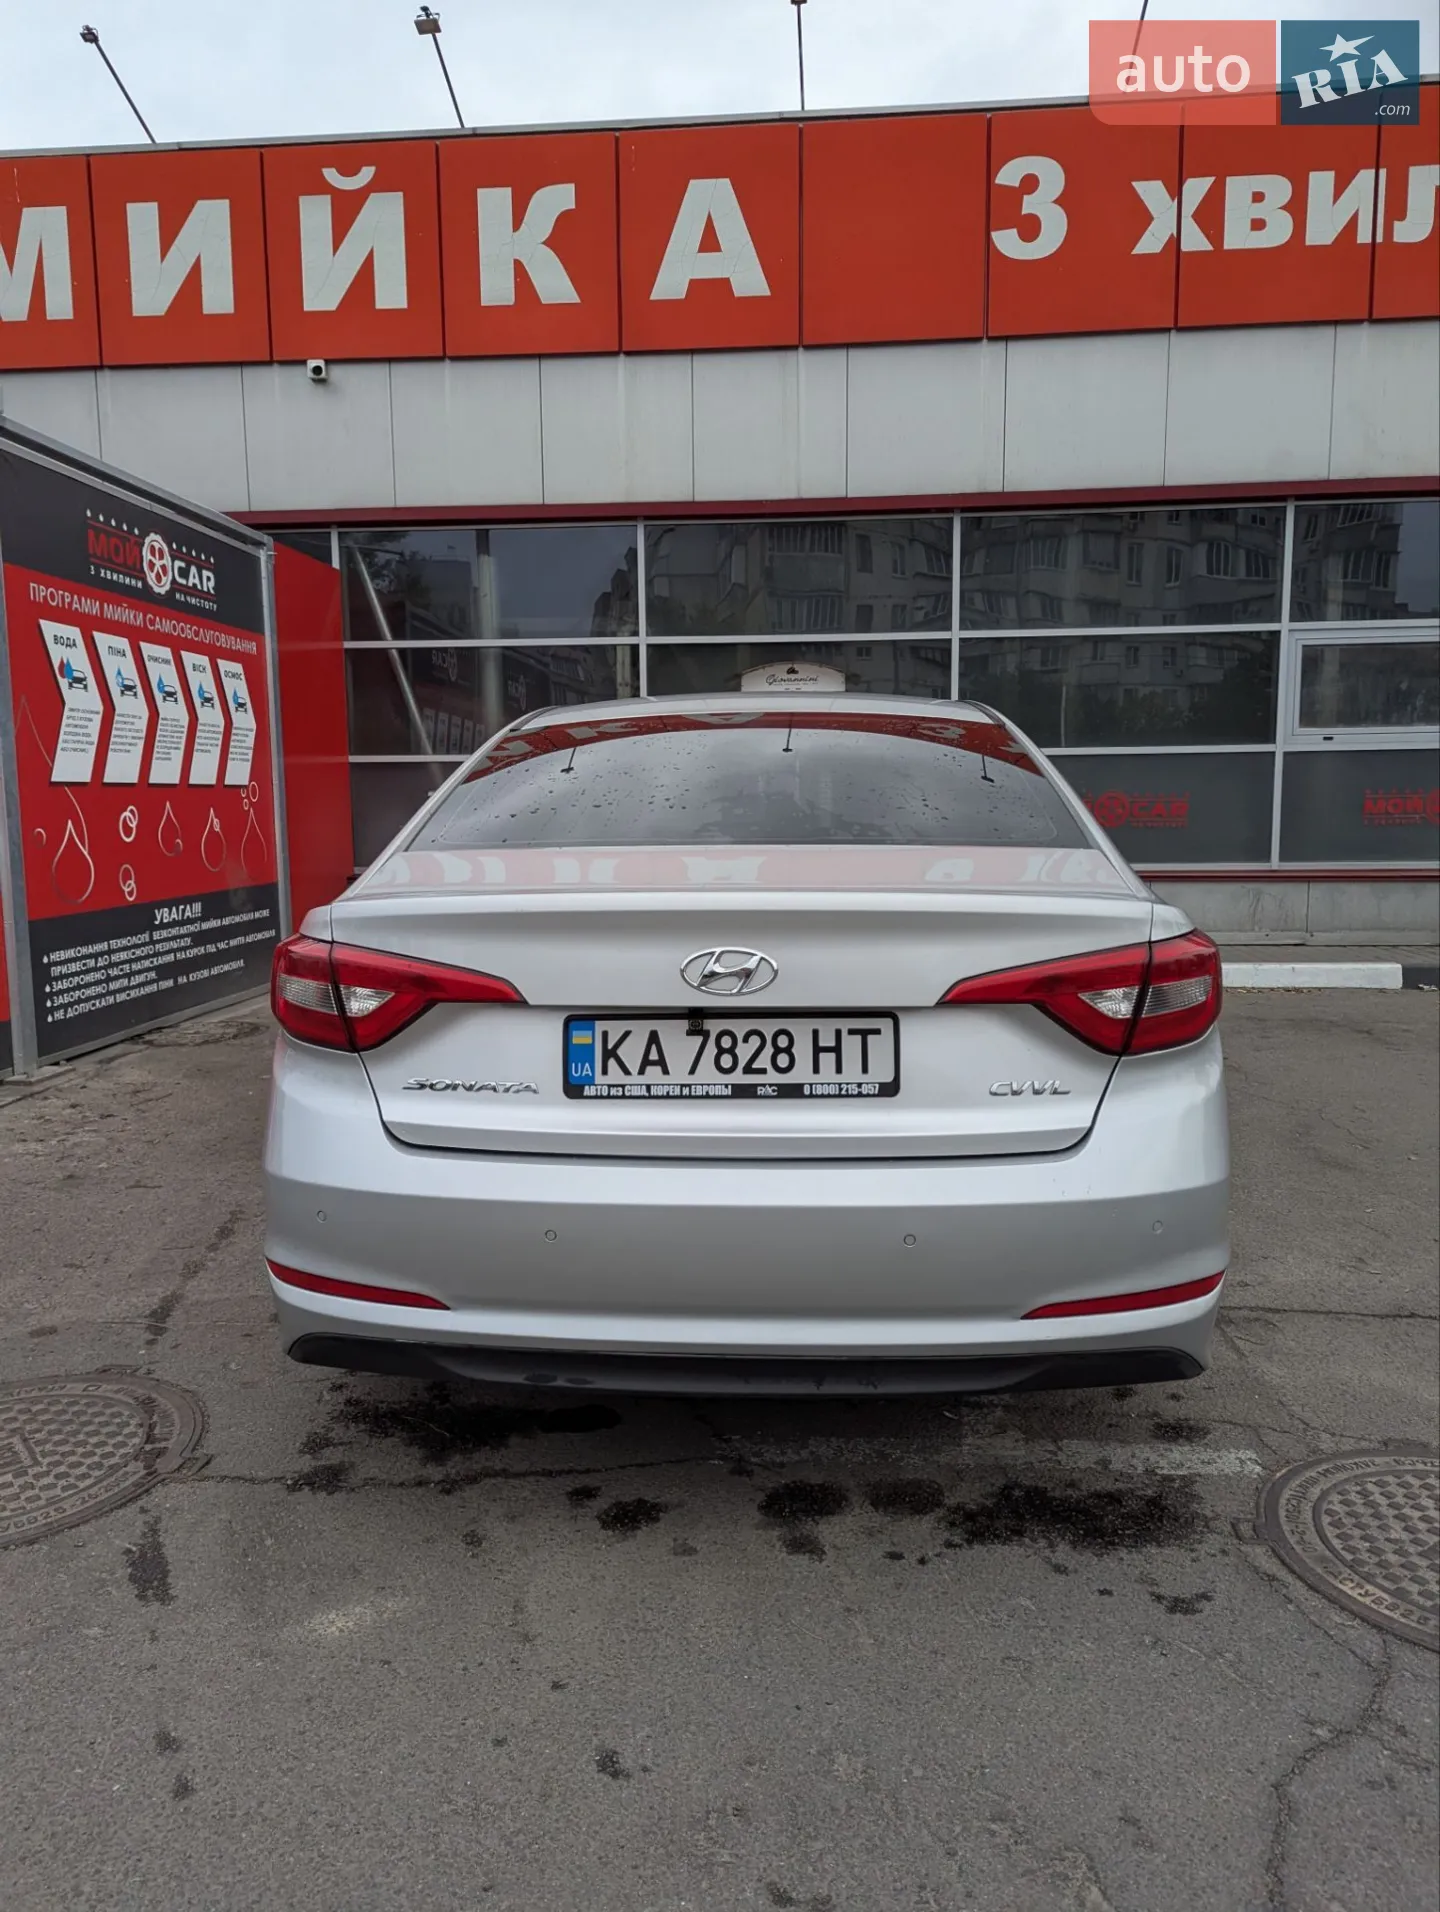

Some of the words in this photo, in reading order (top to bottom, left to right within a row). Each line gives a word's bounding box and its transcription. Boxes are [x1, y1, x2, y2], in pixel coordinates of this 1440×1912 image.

[990, 155, 1069, 261] 3
[99, 568, 143, 590] ХВИЛИНИ
[173, 559, 216, 595] CAR
[175, 591, 185, 603] НА
[185, 596, 218, 612] ЧИСТОТУ
[29, 581, 101, 618] ПРОГРАМИ
[103, 602, 144, 628] МИЙКИ
[146, 613, 257, 656] САМООБСЛУГОВУВАННЯ
[53, 634, 78, 650] ВОДА
[107, 645, 127, 659] ПІНА
[191, 662, 207, 674] ВІСК
[223, 669, 243, 681] ОСМОС
[1131, 800, 1190, 818] CAR
[153, 901, 202, 925] УВАГА!!!
[49, 941, 109, 962] НЕВИКОНАННЯ
[109, 930, 150, 949] ТЕХНОЛОГІЇ
[152, 920, 201, 940] БЕЗКОНТАКТНОЇ
[50, 959, 96, 977] ПРИЗВЕСТИ
[96, 955, 110, 968] ДО
[110, 944, 155, 963] НЕЯКІСНОГО
[154, 936, 194, 953] РЕЗУЛЬТАТУ.
[51, 969, 107, 992] ЗАБОРОНЕНО
[107, 963, 131, 978] ЧАСТЕ
[131, 952, 176, 972] НАТИСКАННЯ
[175, 951, 186, 961] НА
[185, 945, 206, 958] КУРОК
[216, 940, 229, 951] ЧАС
[52, 984, 108, 1007] ЗАБОРОНЕНО
[108, 977, 129, 992] МИТИ
[53, 1008, 66, 1022] НЕ
[66, 994, 115, 1019] ДОПУСКАТИ
[115, 982, 158, 1003] ВИСИХАННЯ
[177, 975, 188, 985] НА
[188, 967, 210, 982] КУЗОВІ
[600, 1028, 671, 1077] KA
[685, 1028, 797, 1077] 7828
[811, 1027, 882, 1076] HT
[571, 1062, 593, 1078] UA
[401, 1077, 540, 1095] SONATA
[583, 1085, 609, 1097] АВТО
[609, 1086, 624, 1097] из
[624, 1085, 649, 1098] США,
[682, 1086, 690, 1097] и
[690, 1085, 732, 1097] ЕВРОПЫ
[803, 1083, 811, 1096] 0
[840, 1083, 880, 1096] 215-057
